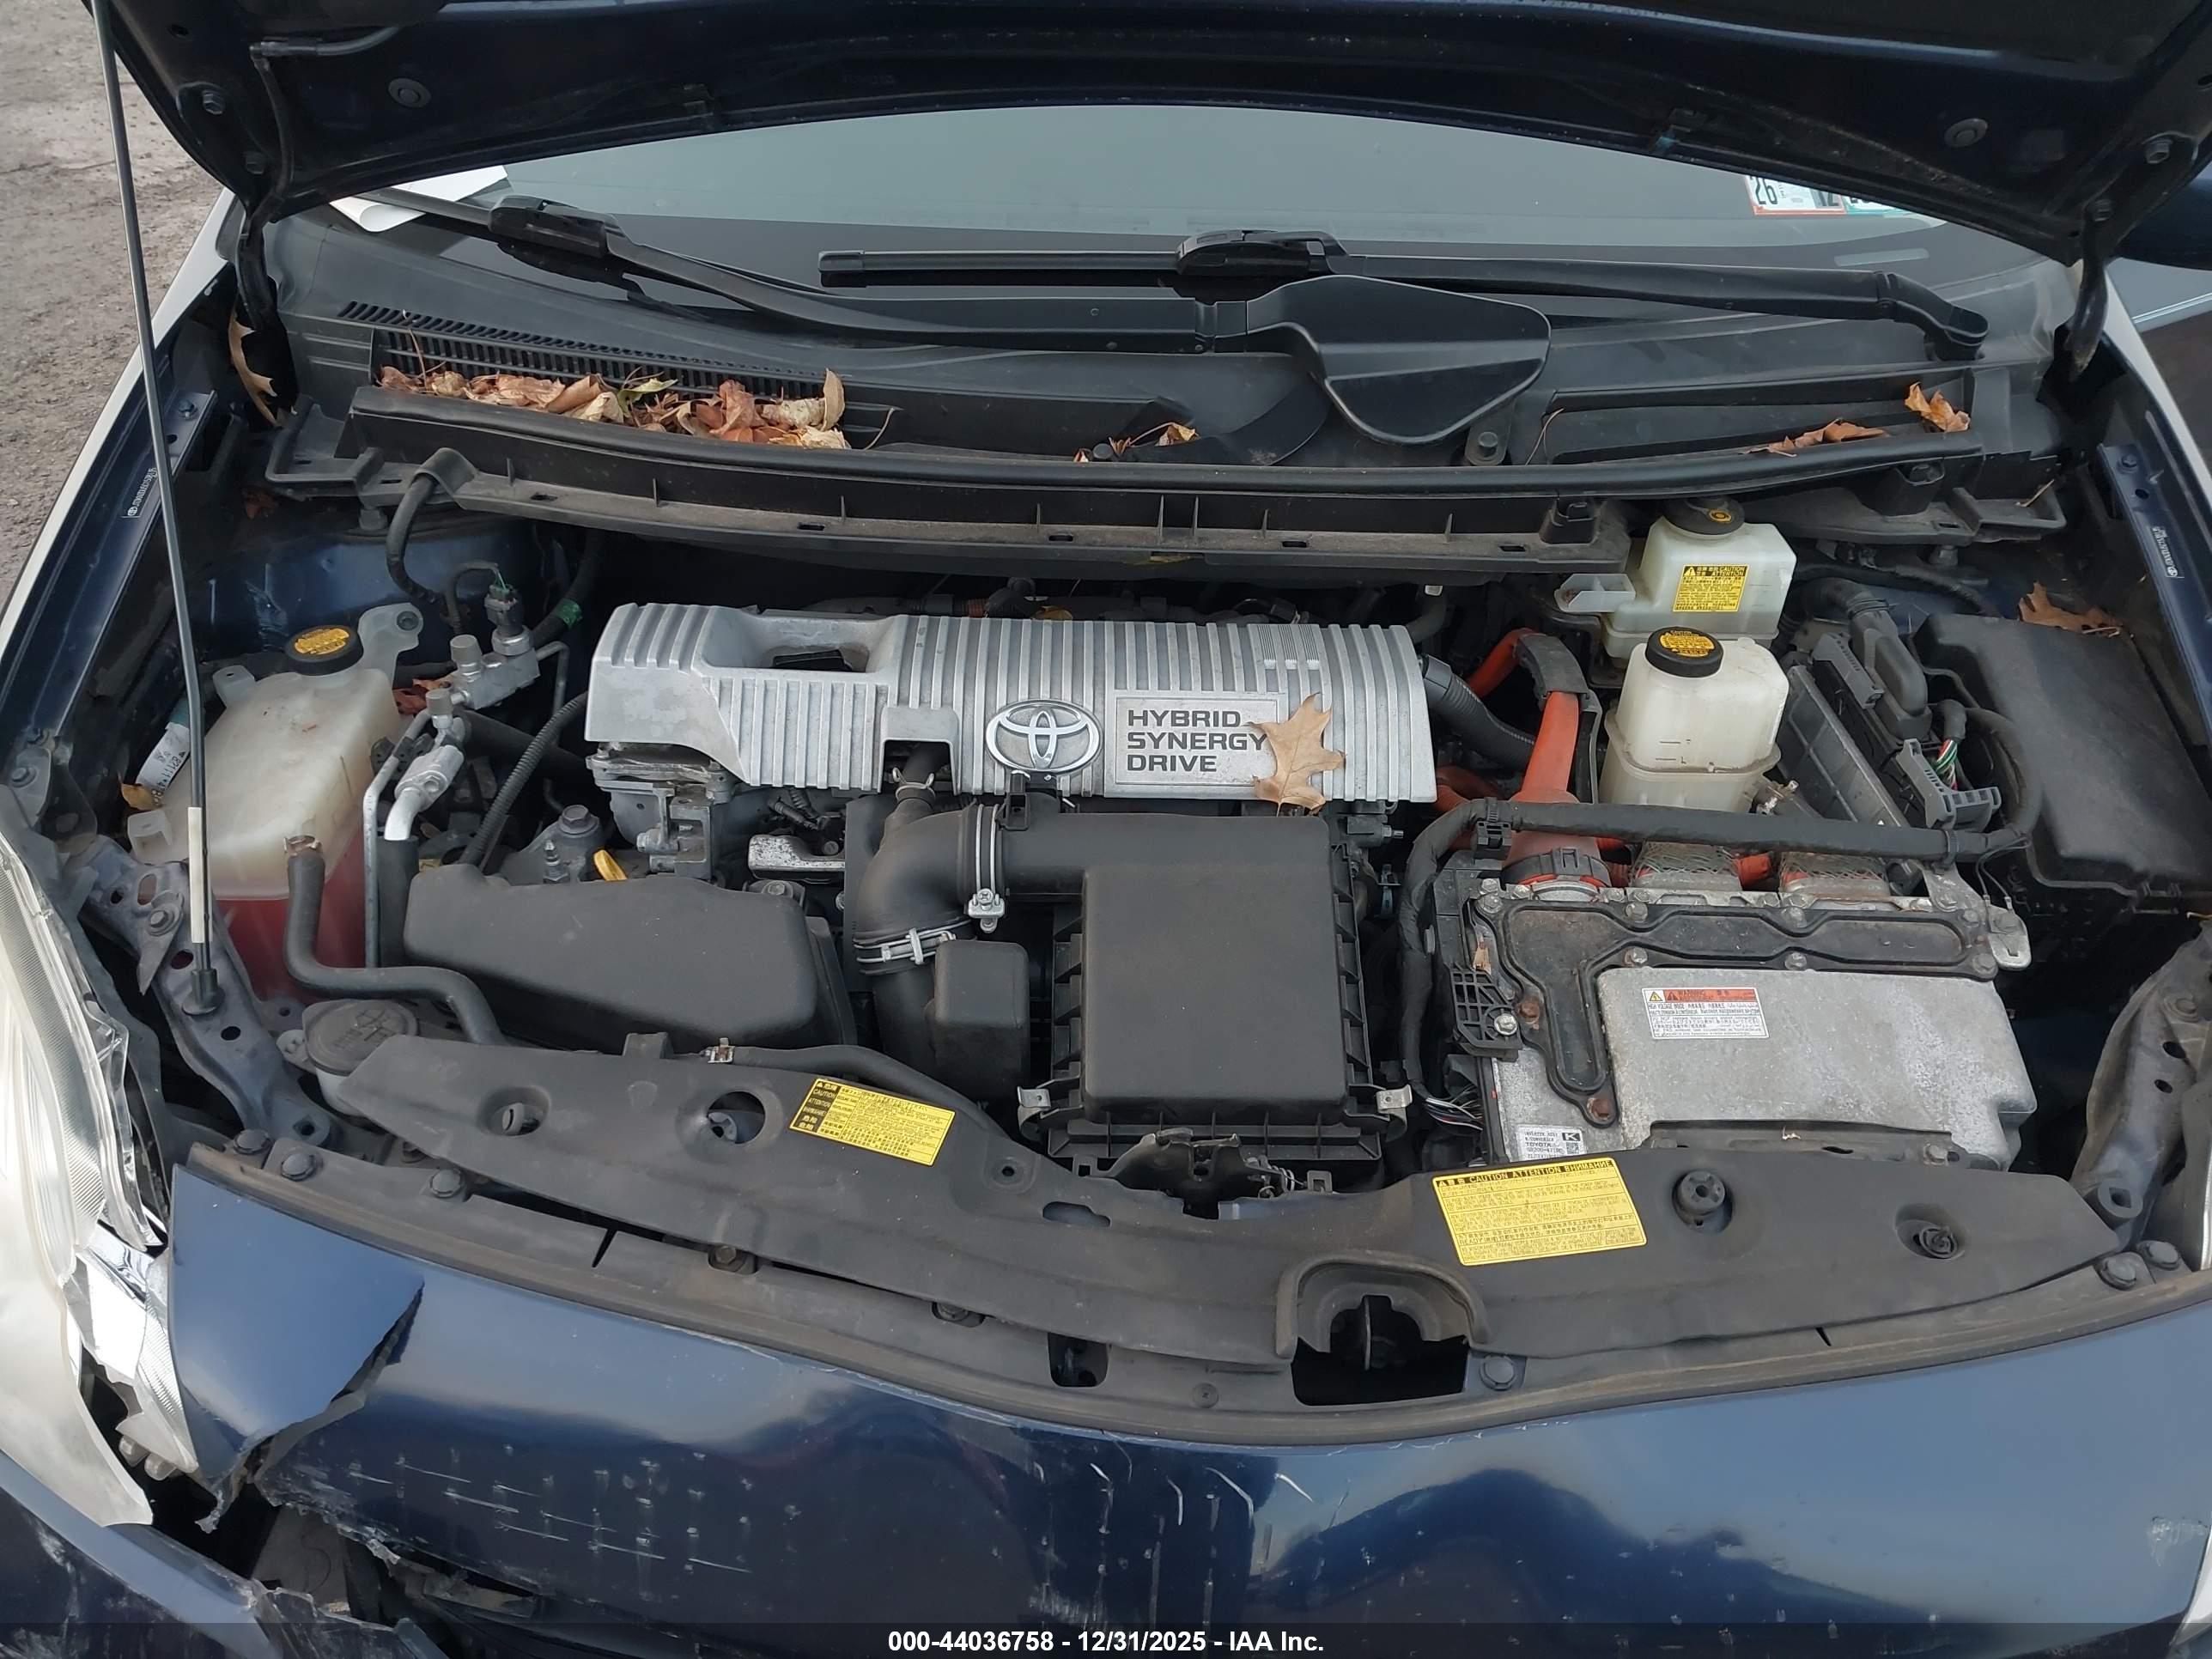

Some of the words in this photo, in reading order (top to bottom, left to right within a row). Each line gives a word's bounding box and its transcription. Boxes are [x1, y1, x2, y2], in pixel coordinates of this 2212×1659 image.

[1750, 175, 1778, 205] 26
[1127, 709, 1241, 727] HYBRID
[1127, 732, 1267, 750] SYNERGY
[1127, 754, 1218, 772] DRIVE
[812, 1089, 836, 1099] CAUTION
[1565, 1133, 1578, 1141] K
[1469, 1171, 1509, 1183] CAUTION
[1512, 1166, 1562, 1178] ATTENTION
